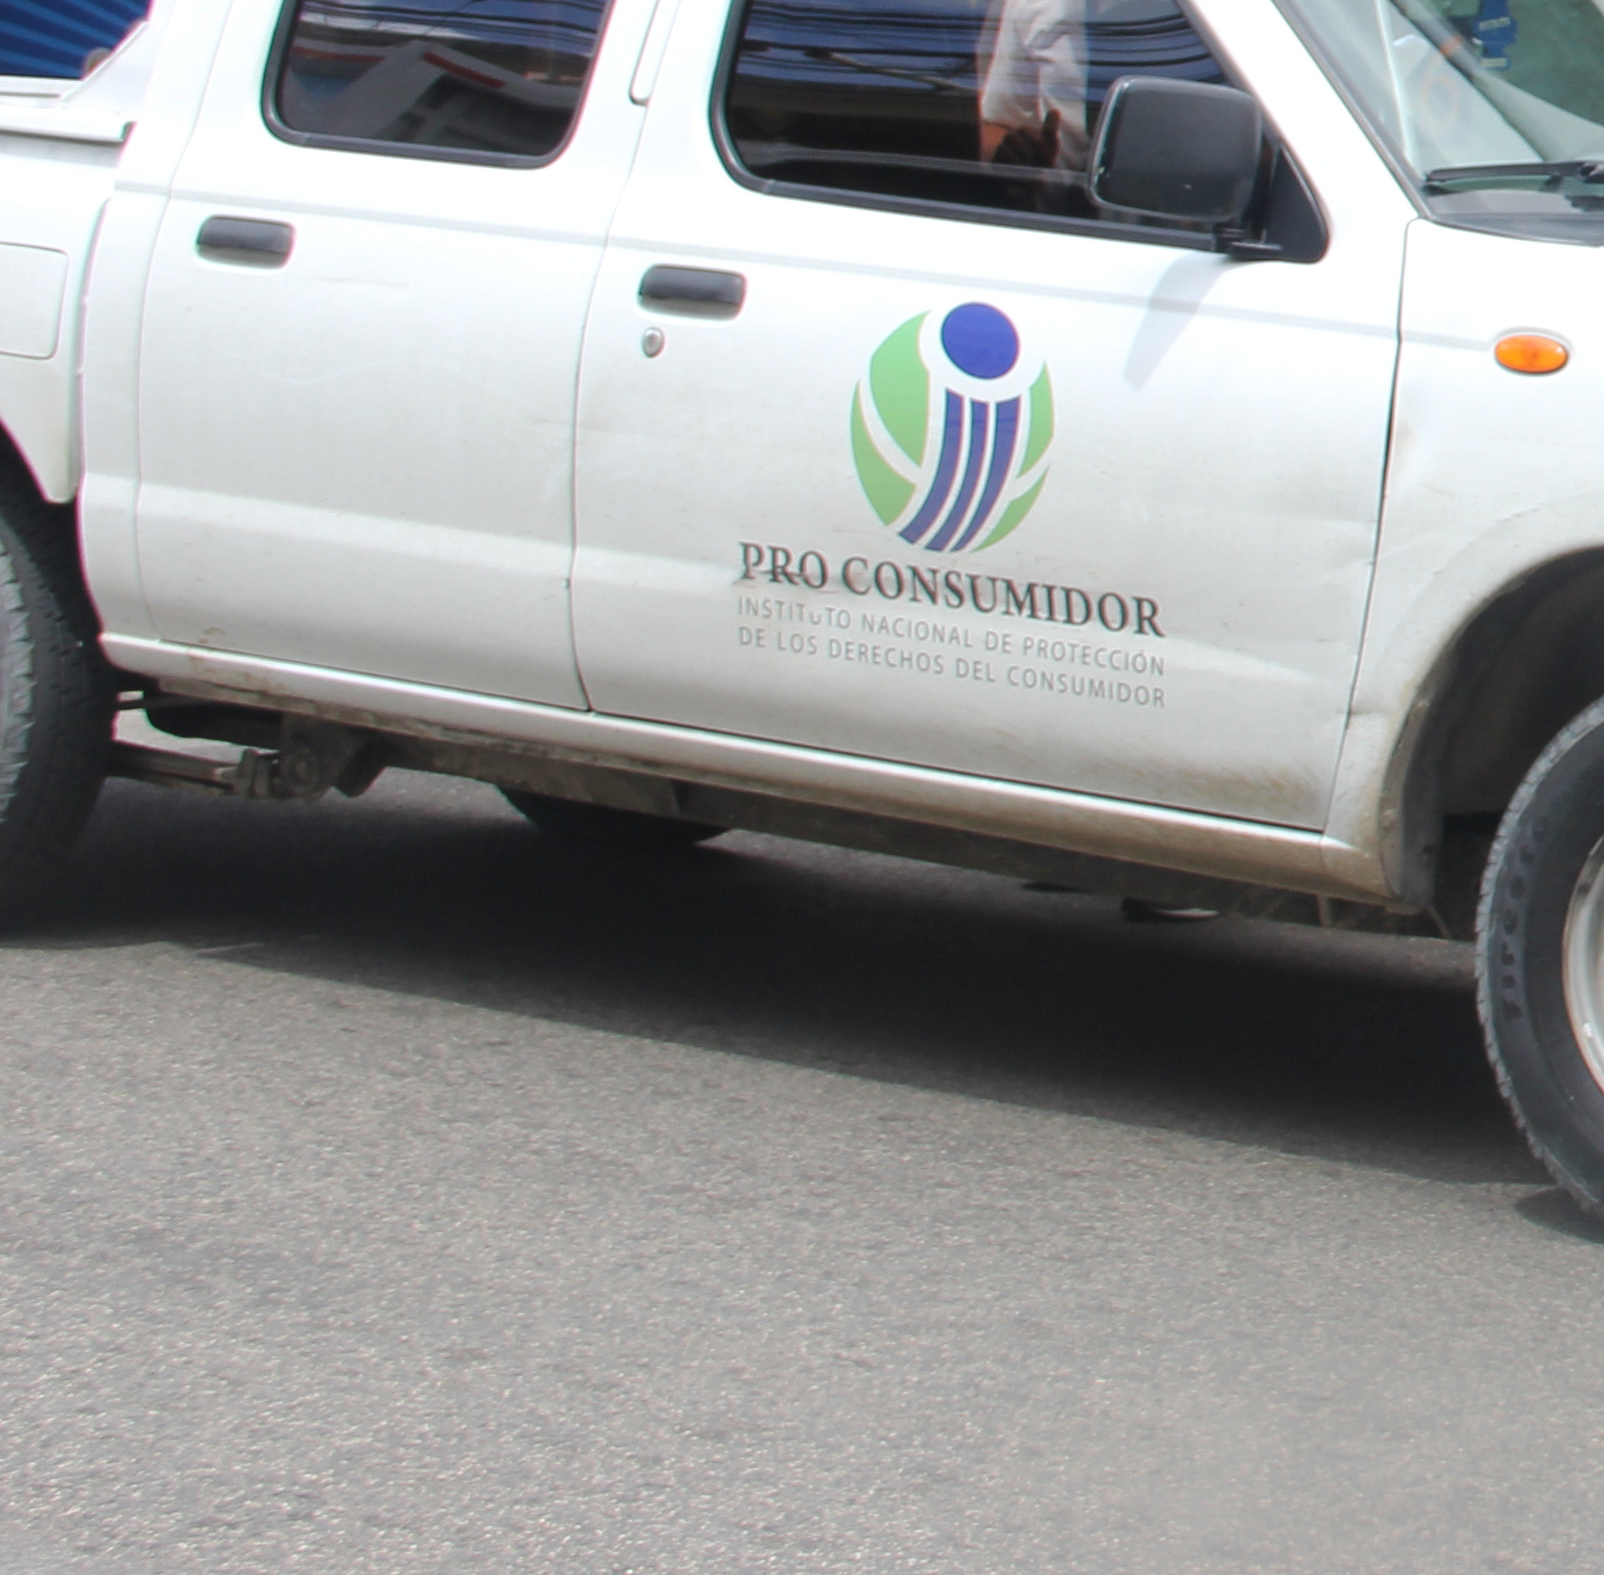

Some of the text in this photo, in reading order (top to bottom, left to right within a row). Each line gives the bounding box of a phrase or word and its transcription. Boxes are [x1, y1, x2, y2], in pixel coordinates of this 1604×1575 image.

[738, 542, 1167, 638] PRO CONSUMIDOR
[738, 626, 1166, 709] DE LOS DERECHOS DEL CONSUMIDOR
[861, 613, 974, 649] NACIONAL
[984, 629, 1013, 654] DE
[1022, 634, 1166, 677] PROTECCIÓN
